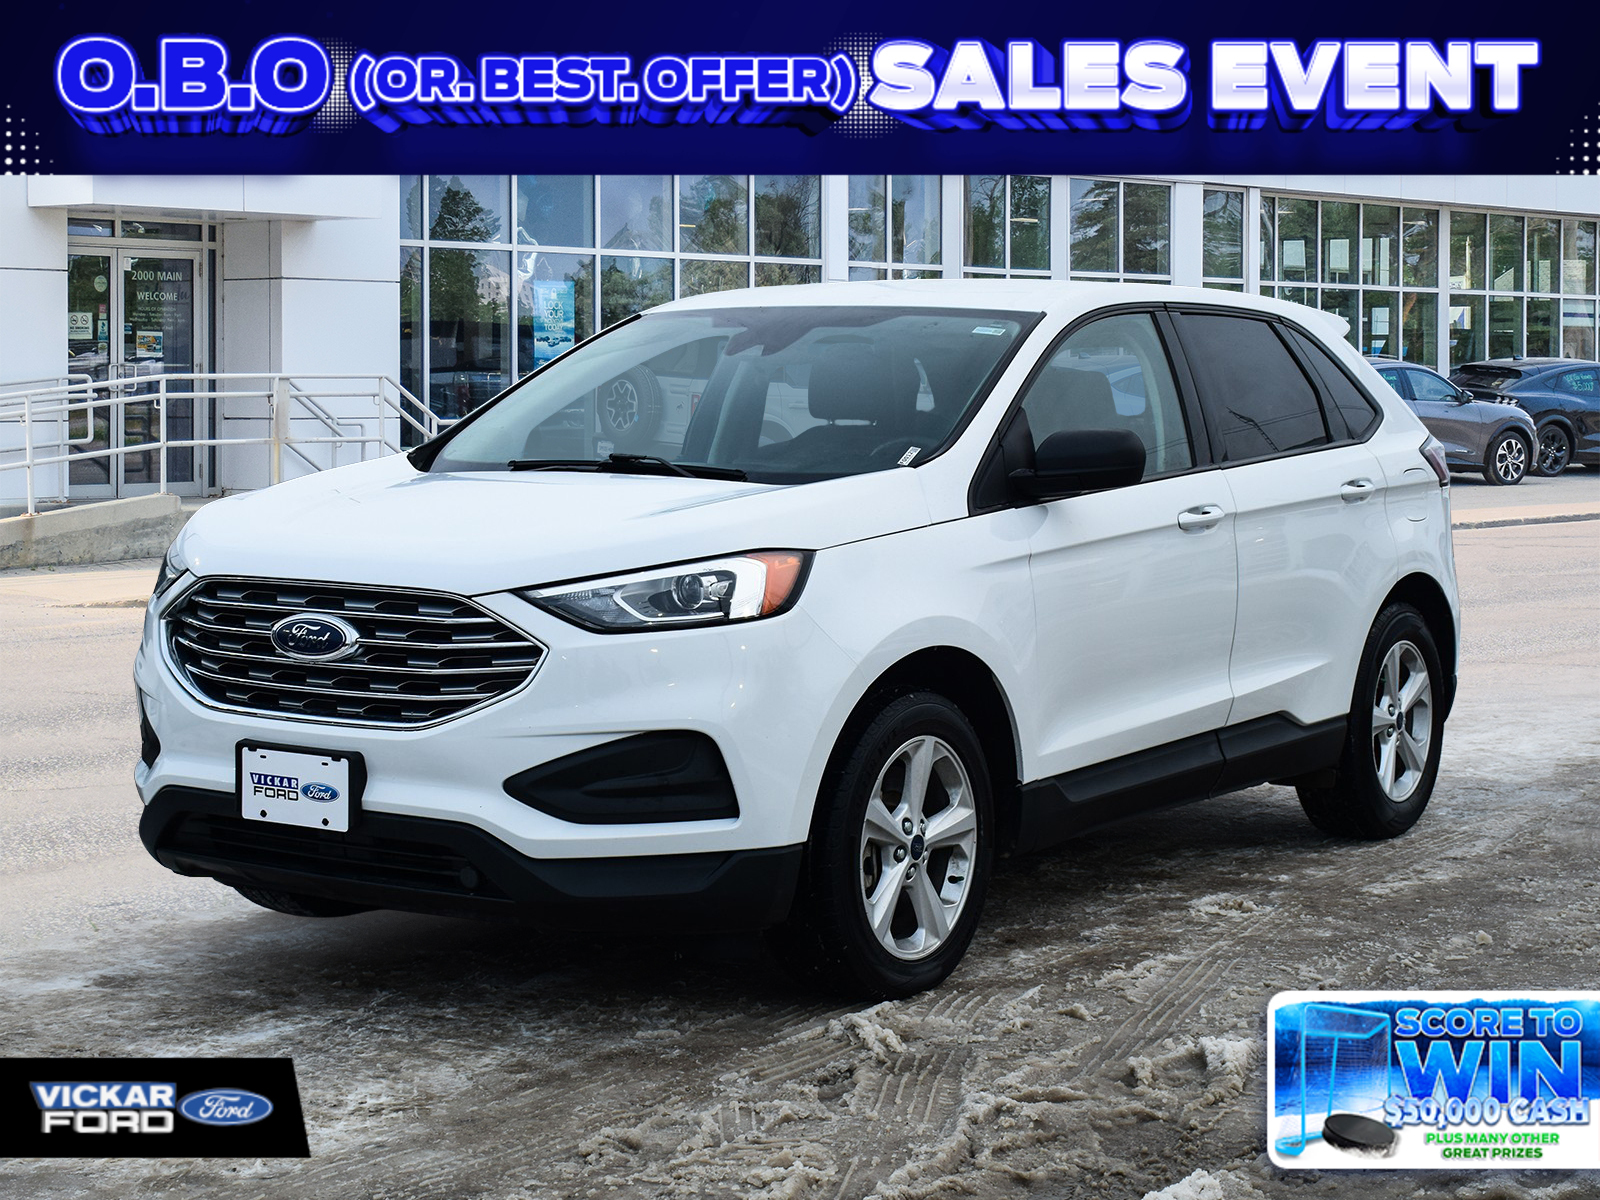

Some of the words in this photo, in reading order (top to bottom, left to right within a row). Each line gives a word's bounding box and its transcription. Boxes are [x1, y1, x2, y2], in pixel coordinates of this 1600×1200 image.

[131, 270, 155, 281] 2000
[157, 271, 183, 281] MAIN
[136, 291, 178, 301] WELCOME
[544, 310, 564, 318] YOUR
[252, 774, 299, 790] VICKAR
[253, 786, 299, 801] FORD
[307, 784, 333, 801] Ford
